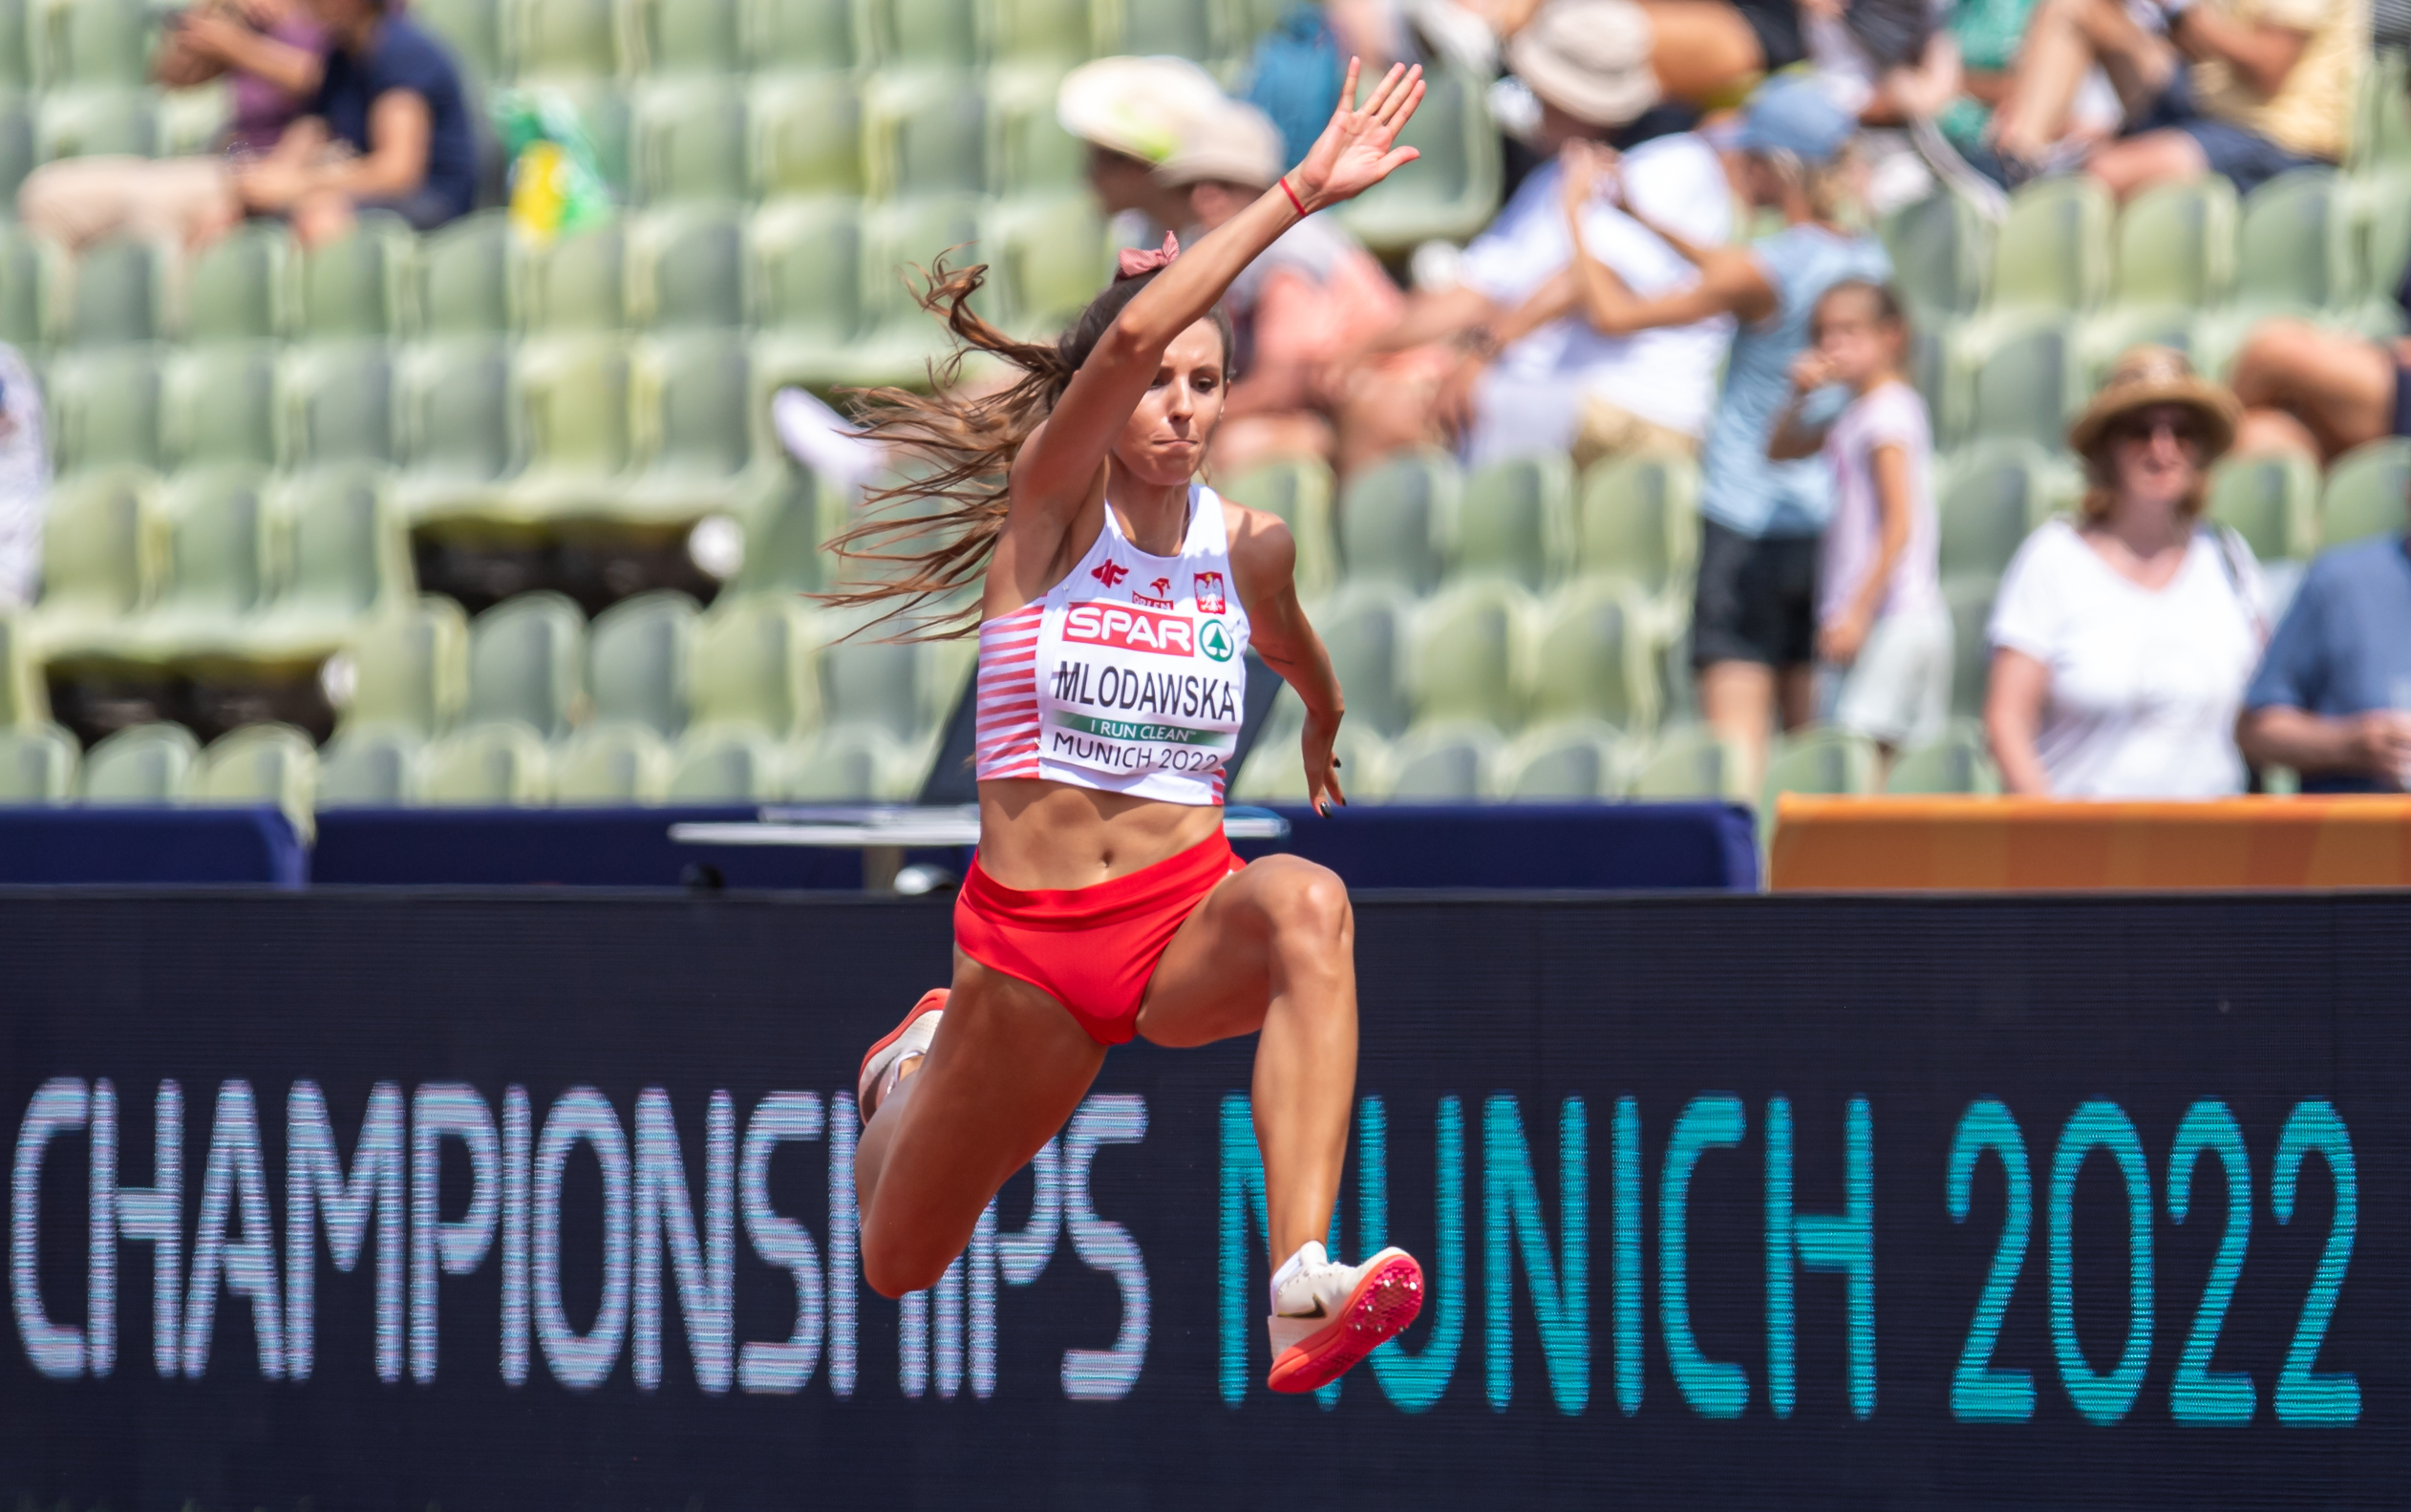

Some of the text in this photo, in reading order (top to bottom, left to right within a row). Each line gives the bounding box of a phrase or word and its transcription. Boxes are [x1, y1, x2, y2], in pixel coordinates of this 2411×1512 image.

[1067, 607, 1191, 651] SPAR
[1055, 660, 1236, 722] MLODAWSKA
[1091, 719, 1096, 733] I
[1100, 720, 1137, 739] RUN
[1053, 732, 1218, 772] MUNICH 2022
[1219, 1091, 1877, 1421] MUNICH
[1945, 1094, 2362, 1428] 2022
